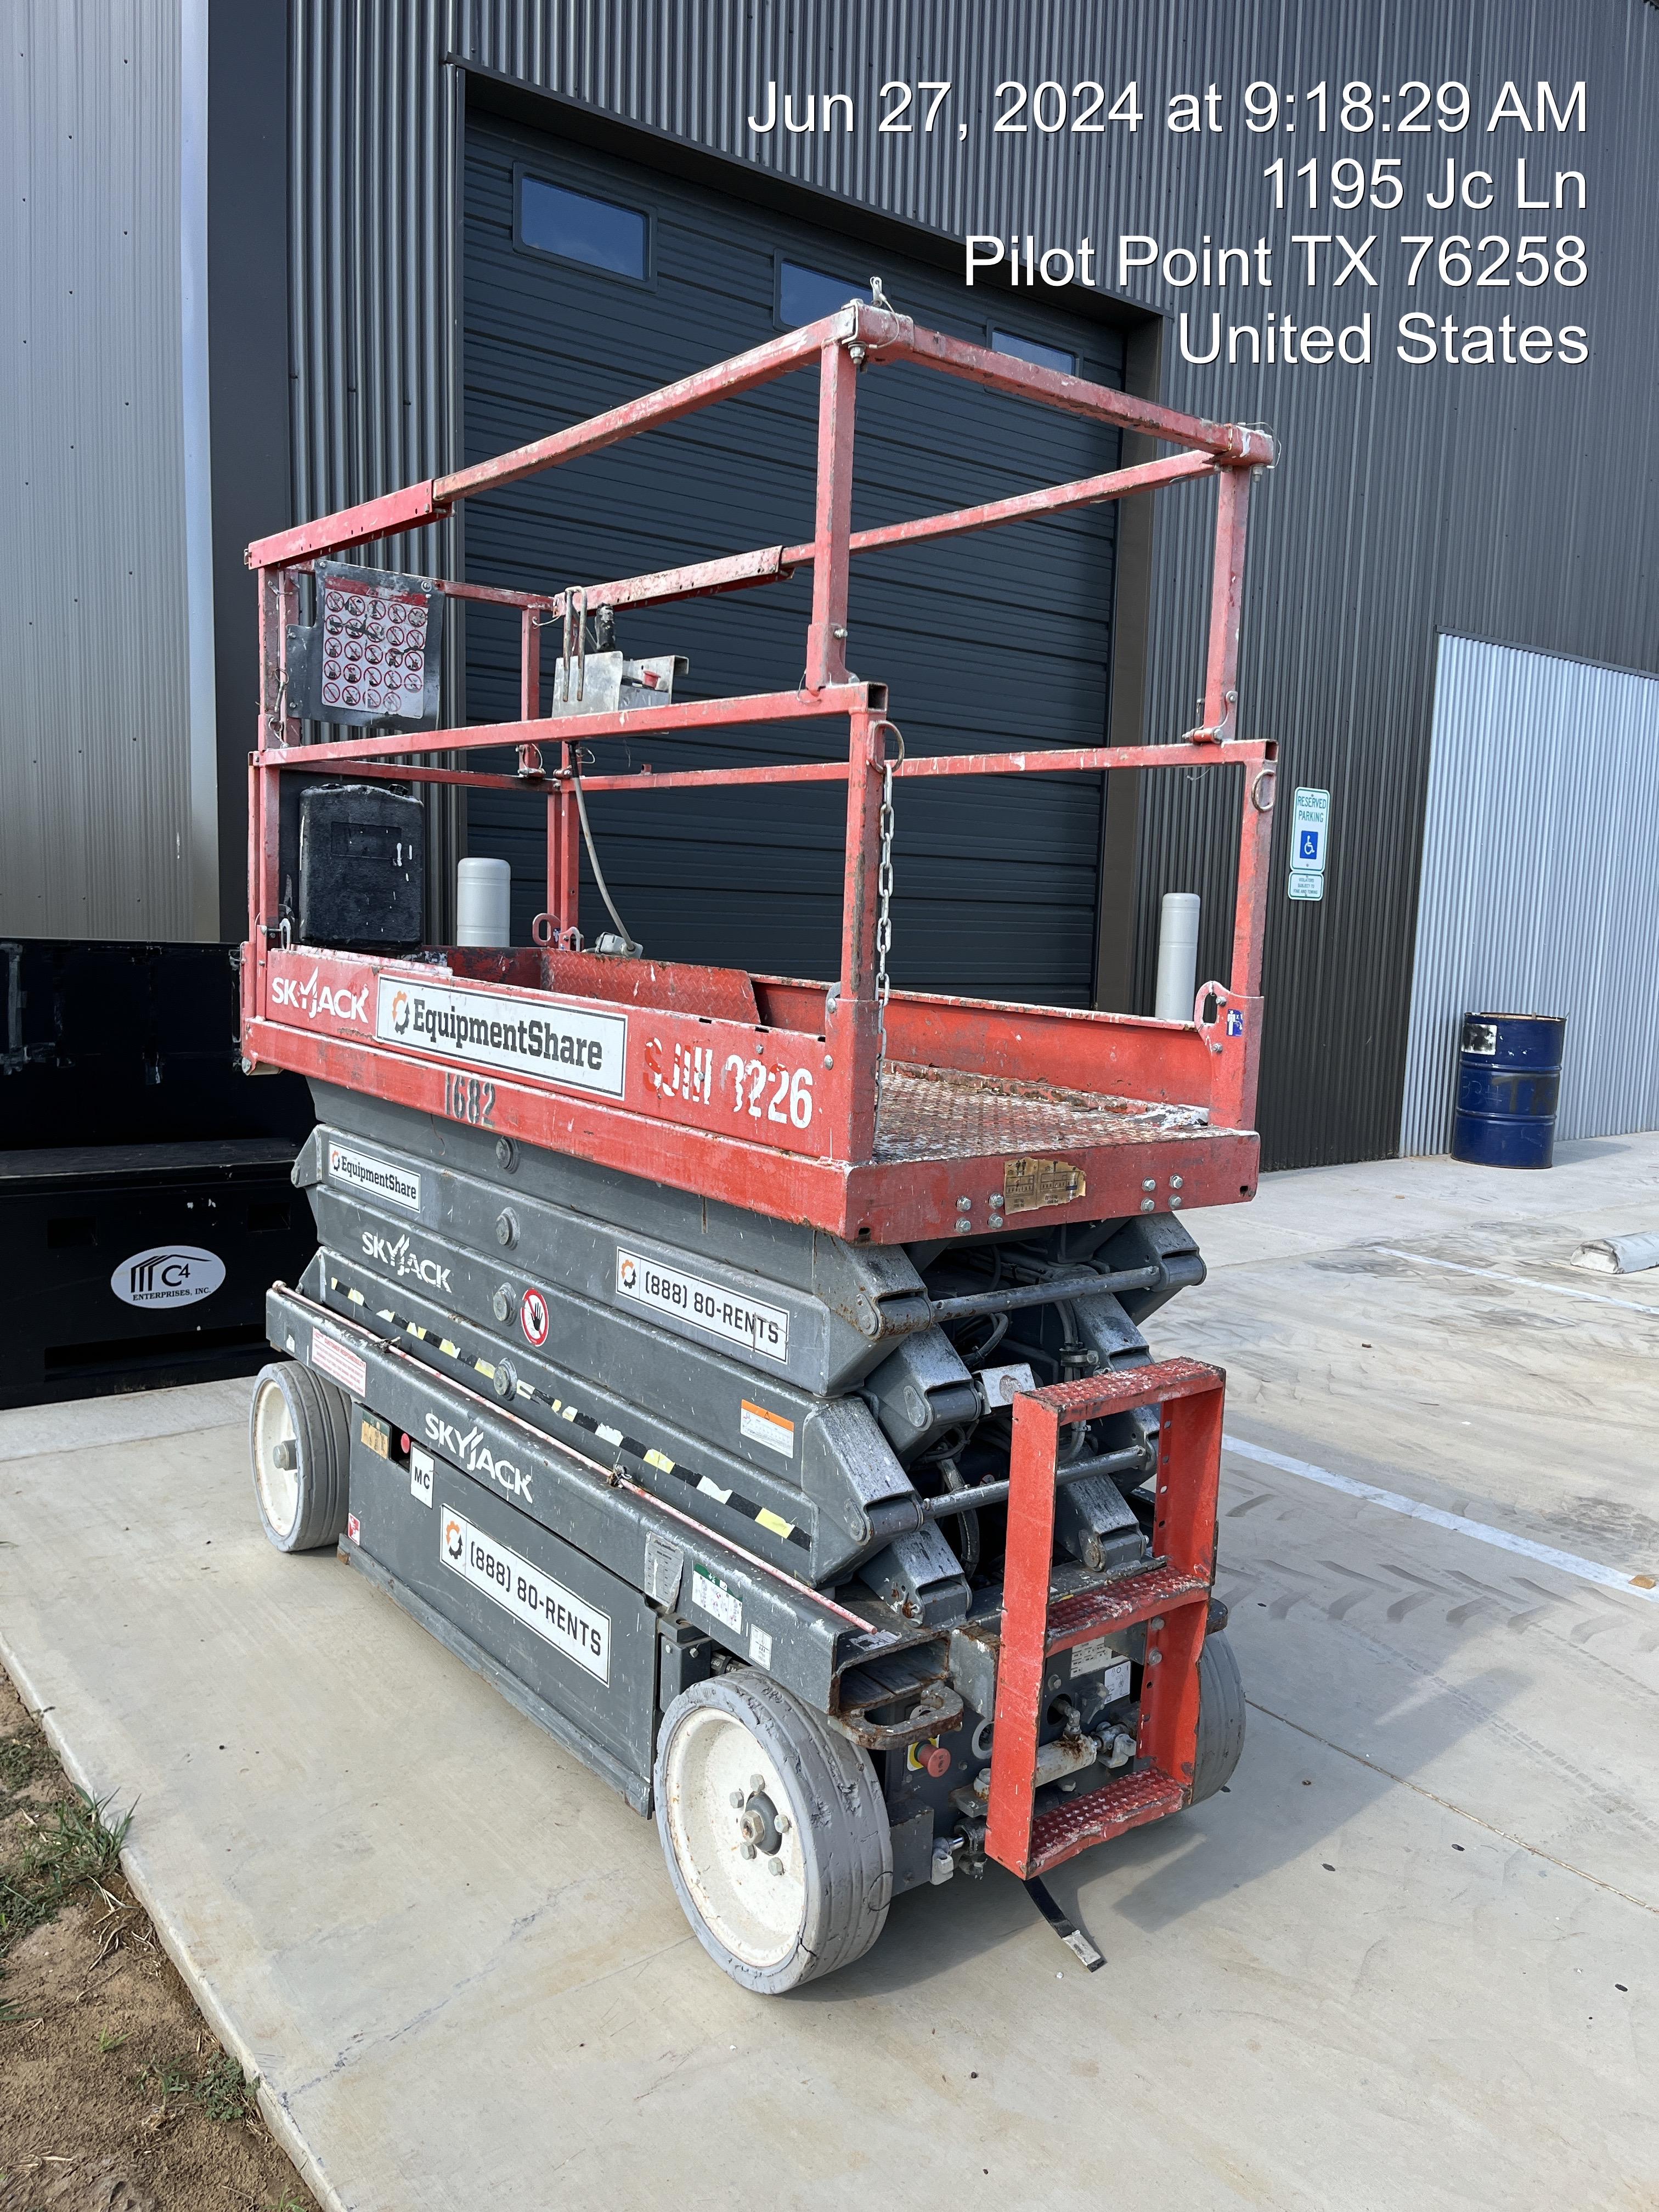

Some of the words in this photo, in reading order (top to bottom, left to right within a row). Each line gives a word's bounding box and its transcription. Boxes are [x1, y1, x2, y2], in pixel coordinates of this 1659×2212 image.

[1297, 795, 1327, 809] RESERVED
[1298, 810, 1324, 822] PARKING
[272, 967, 369, 1024] SKYJACK
[413, 998, 602, 1070] EquipmentShare
[445, 1071, 496, 1129] 1682
[341, 1155, 416, 1200] EquipmentShare
[362, 1231, 453, 1294] SKYJACK
[133, 1289, 193, 1301] ENTERPRISES,
[195, 1286, 211, 1295] INC.
[645, 1271, 687, 1309] (888)
[694, 1291, 778, 1344] 80-RENTS
[414, 1466, 431, 1489] MC
[425, 1413, 533, 1504] SKYJACK
[470, 1541, 511, 1593] (888)
[517, 1576, 601, 1656] 80-RENTS
